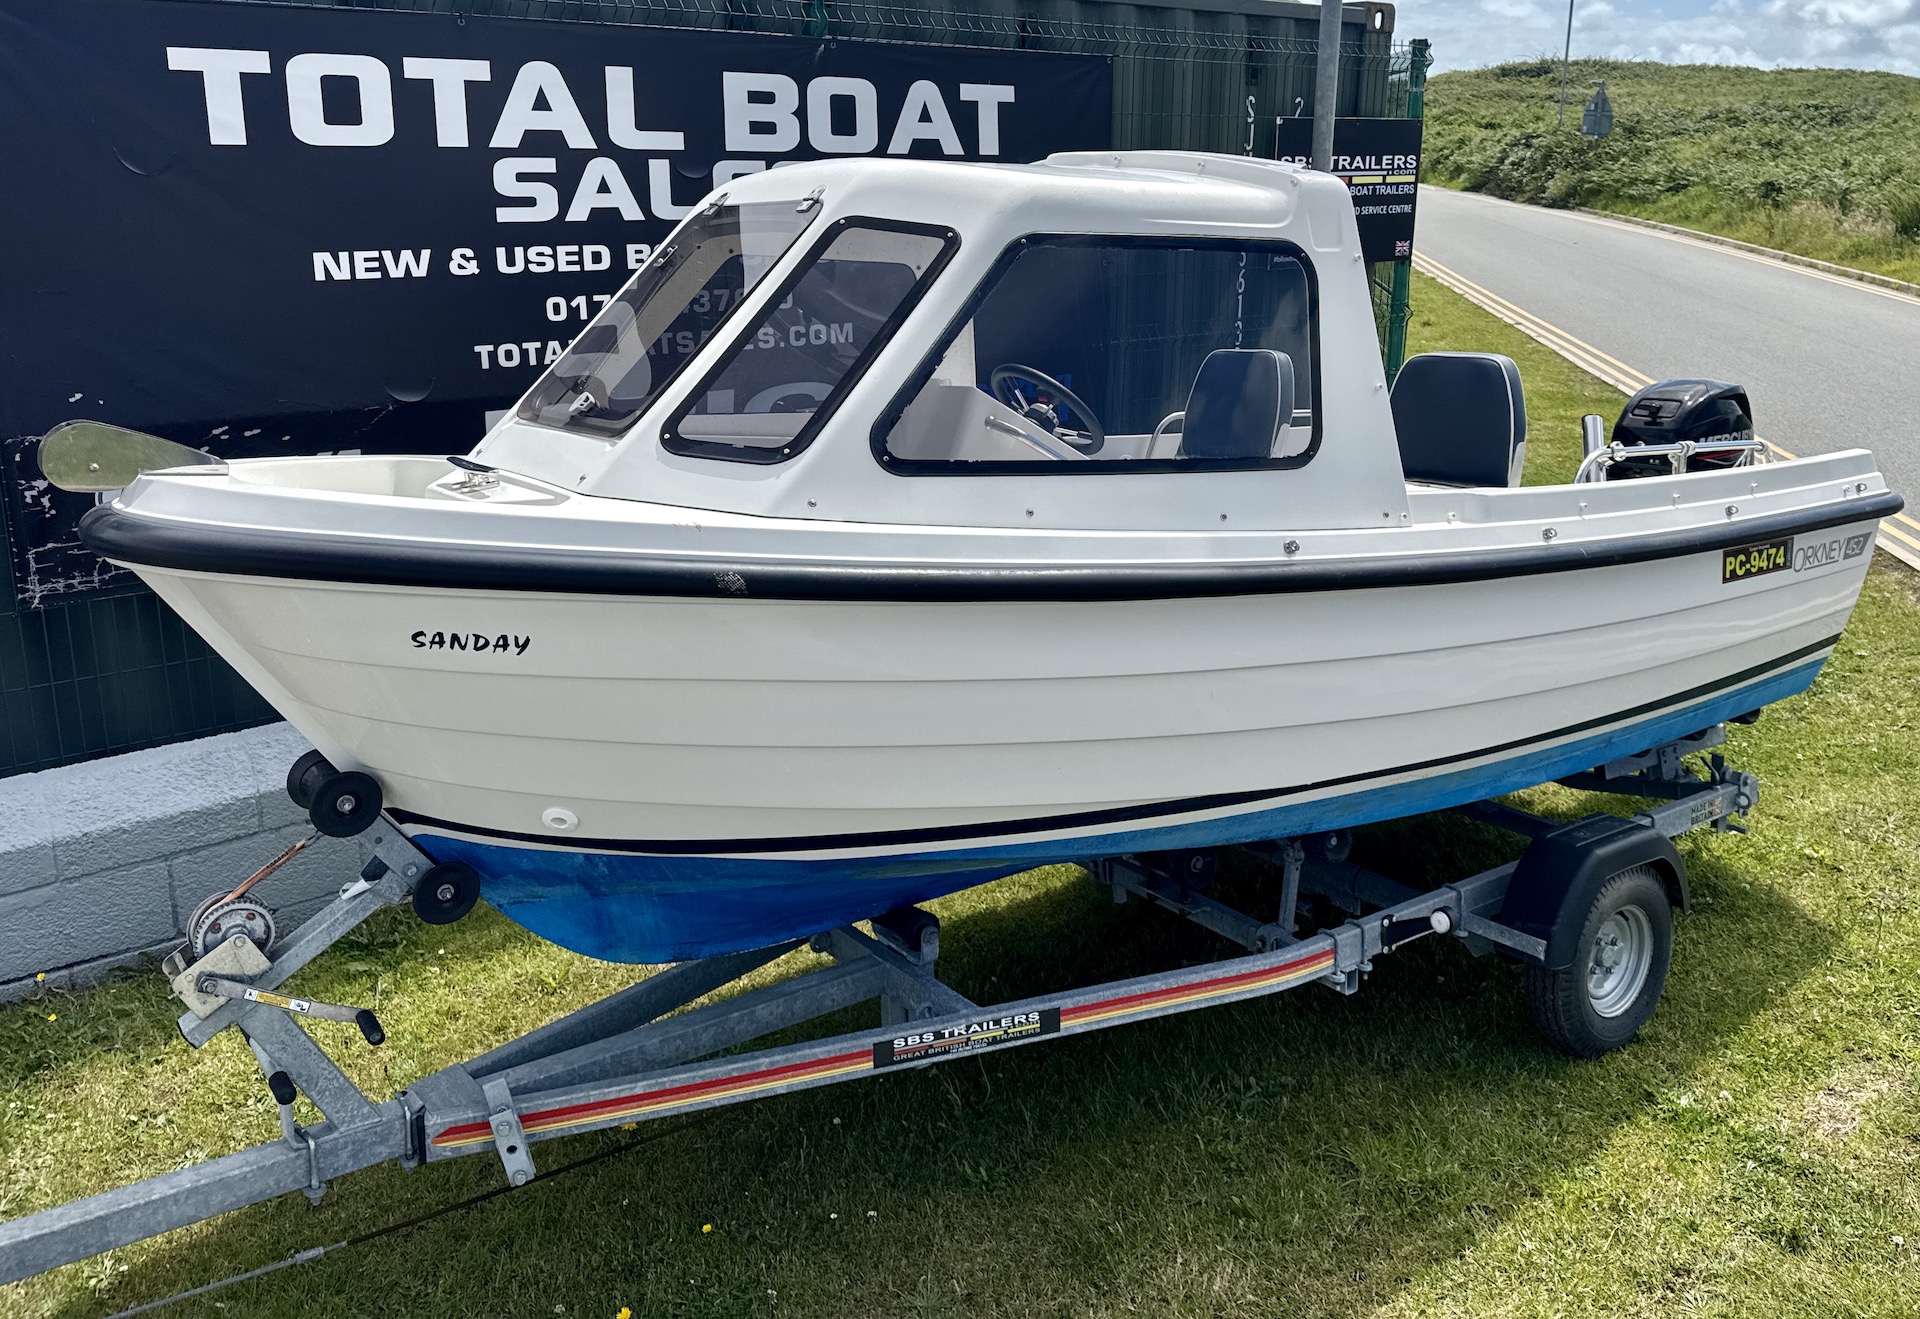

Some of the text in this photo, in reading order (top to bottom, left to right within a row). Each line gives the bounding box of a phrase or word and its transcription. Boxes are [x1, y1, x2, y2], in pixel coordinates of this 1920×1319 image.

[166, 47, 1016, 157] TOTAL BOAT
[1330, 155, 1417, 170] TRAILERS
[493, 156, 805, 222] SAL
[1350, 183, 1415, 196] BOAT TRAILERS
[1360, 205, 1387, 215] SERVICE
[1388, 204, 1412, 214] CENTRE
[313, 249, 431, 282] NEW
[449, 247, 480, 276] &
[495, 244, 611, 274] USED
[546, 294, 614, 321] 017
[1725, 546, 1785, 578] PC-9474
[1793, 538, 1846, 572] ORKNEY
[1846, 537, 1864, 556] 452
[411, 630, 531, 656] SANDAY
[893, 1033, 934, 1048] SBS
[941, 1011, 1040, 1039] TRAILERS
[893, 1050, 926, 1061] GREAT
[928, 1042, 965, 1055] BRITISH
[968, 1036, 993, 1047] BOAT
[994, 1027, 1040, 1040] TRAILERS
